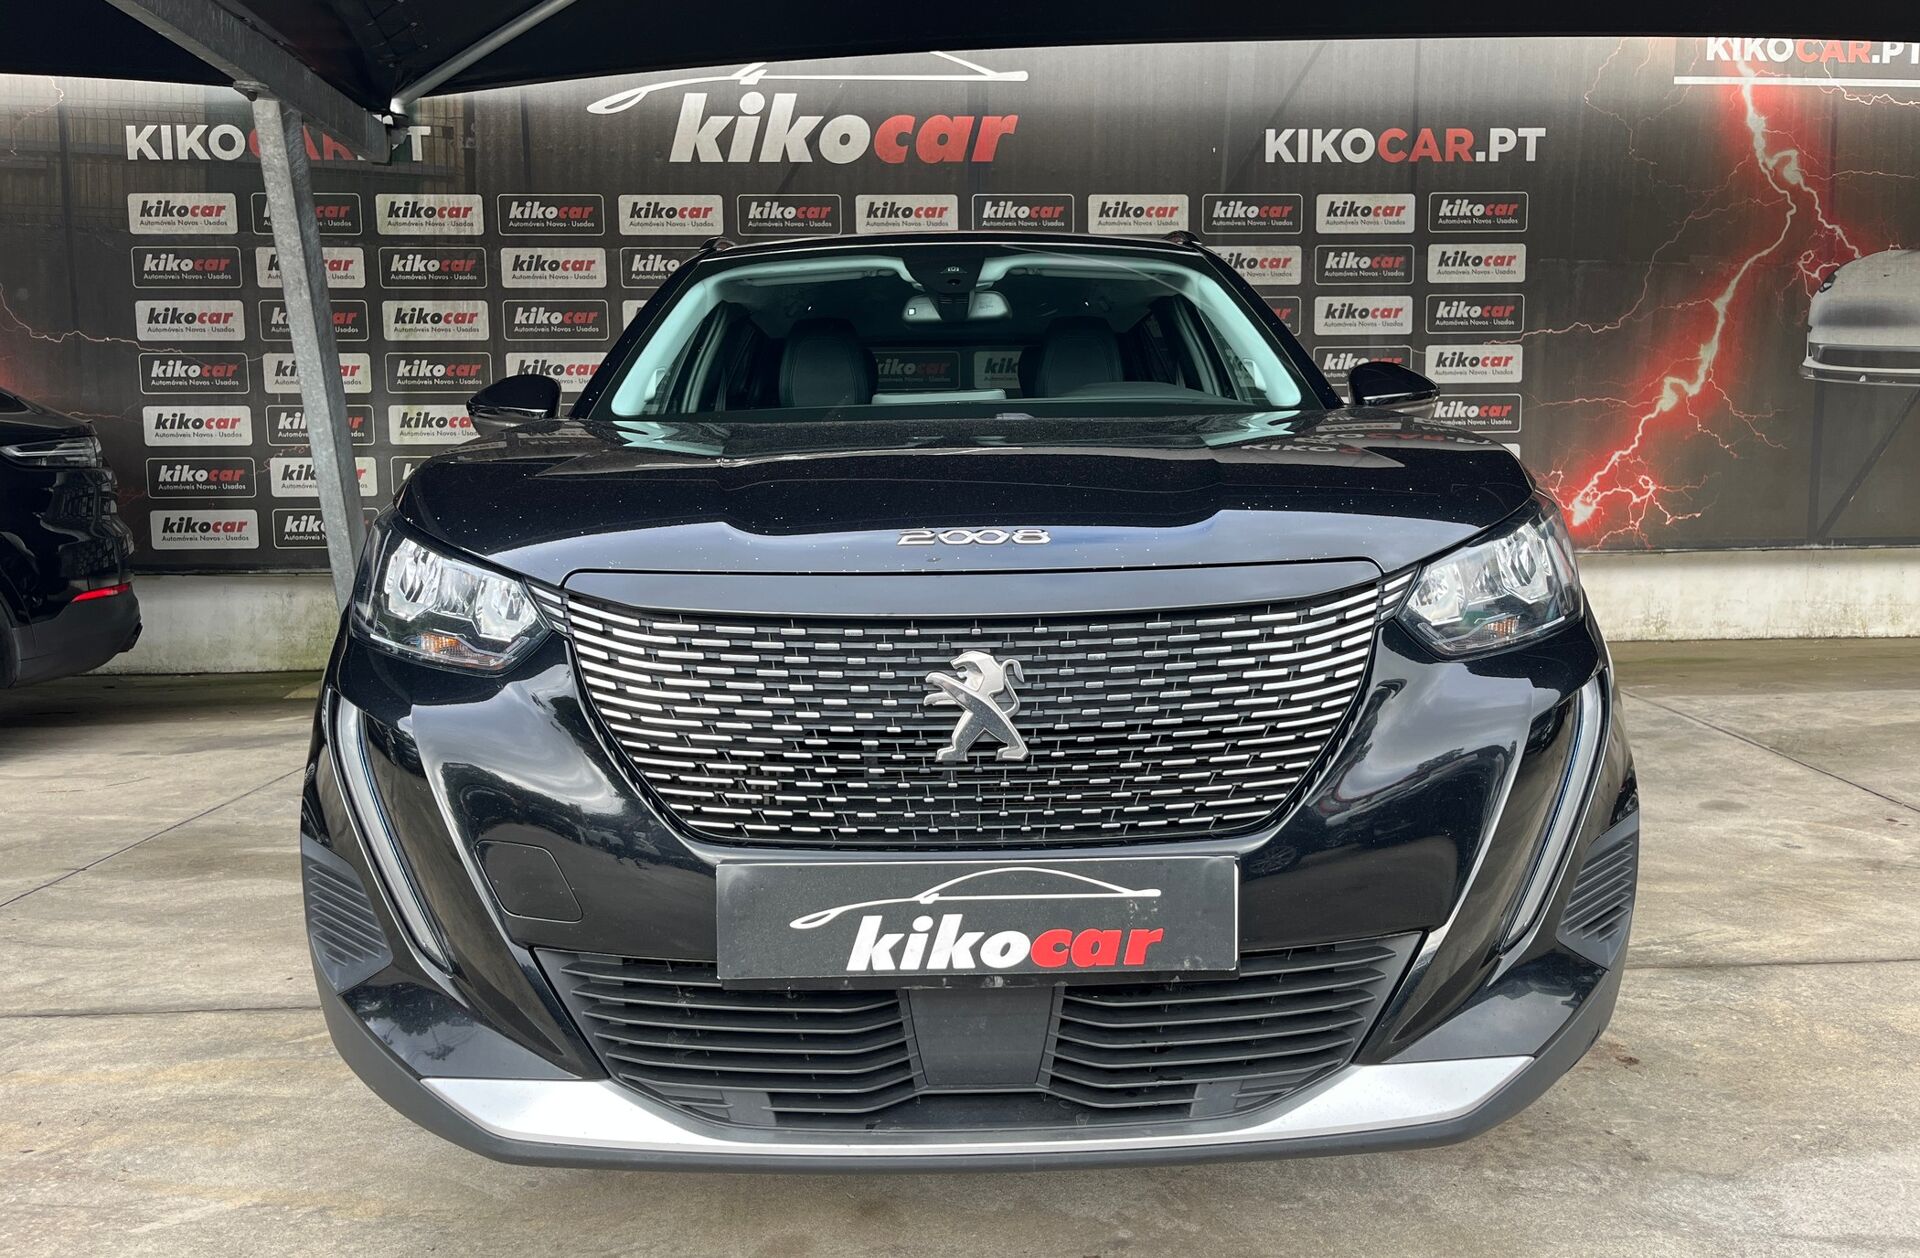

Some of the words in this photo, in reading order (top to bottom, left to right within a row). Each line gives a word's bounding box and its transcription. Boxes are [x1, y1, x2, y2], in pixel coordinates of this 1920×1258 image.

[669, 91, 1019, 164] kikocar
[1265, 127, 1547, 163] KIKOCAR.PT
[140, 200, 227, 218] kikocar
[387, 201, 474, 219] kikocar
[509, 201, 594, 219] kikocar
[630, 202, 713, 219] kikocar
[748, 202, 832, 220] kikocar
[866, 202, 949, 218] kikocar
[983, 201, 1065, 219] kikocar
[1098, 201, 1180, 218] kikocar
[1213, 201, 1293, 218] kikocar
[1327, 201, 1406, 217] kikocar
[1439, 199, 1519, 216] kikocar
[144, 254, 230, 271] kikocar
[391, 254, 476, 271] kikocar
[512, 255, 596, 271] kikocar
[631, 254, 680, 272] kiko
[1218, 253, 1292, 269] ikocar
[1325, 252, 1406, 269] kikocar
[1438, 251, 1517, 267] kikocar
[147, 307, 234, 324] kikocar
[394, 308, 479, 324] kikocar
[514, 307, 598, 324] kikocar
[1325, 303, 1404, 319] kikocar
[1436, 301, 1515, 318] kikocar
[151, 360, 238, 377] kikocar
[397, 360, 482, 376] kikocar
[1435, 352, 1514, 368] kikocar
[1434, 401, 1512, 418] kikocar
[155, 413, 241, 430] kikocar
[400, 412, 473, 428] kikoca
[157, 465, 246, 482] kikocar
[157, 483, 193, 491] Automóveis
[195, 483, 216, 491] Novos
[221, 483, 245, 491] Usados
[162, 516, 249, 534] kikocar
[897, 529, 1051, 545] 2008
[845, 914, 1164, 972] kikocar
